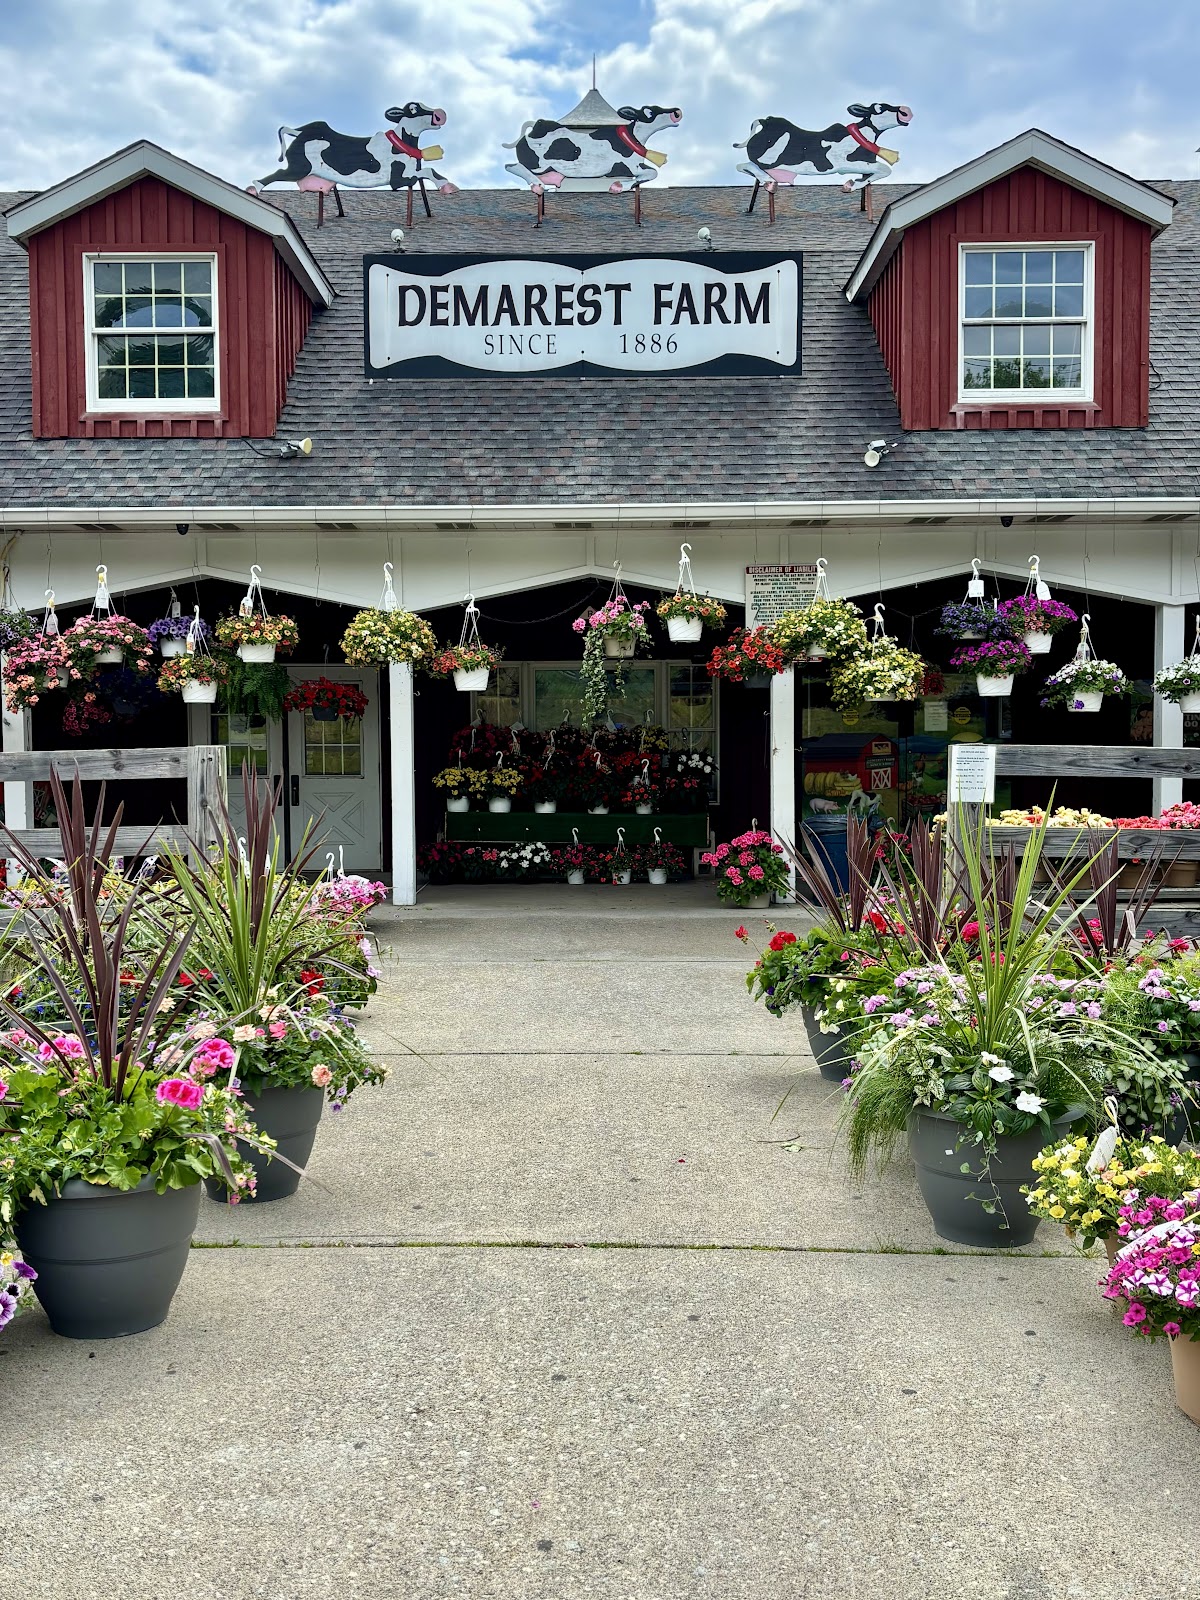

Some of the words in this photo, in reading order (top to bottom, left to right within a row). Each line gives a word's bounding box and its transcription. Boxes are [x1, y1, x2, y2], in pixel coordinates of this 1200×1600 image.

[397, 282, 632, 328] DEMAREST
[653, 281, 771, 326] FARM
[484, 333, 558, 356] SINCE
[619, 333, 678, 355] 1886
